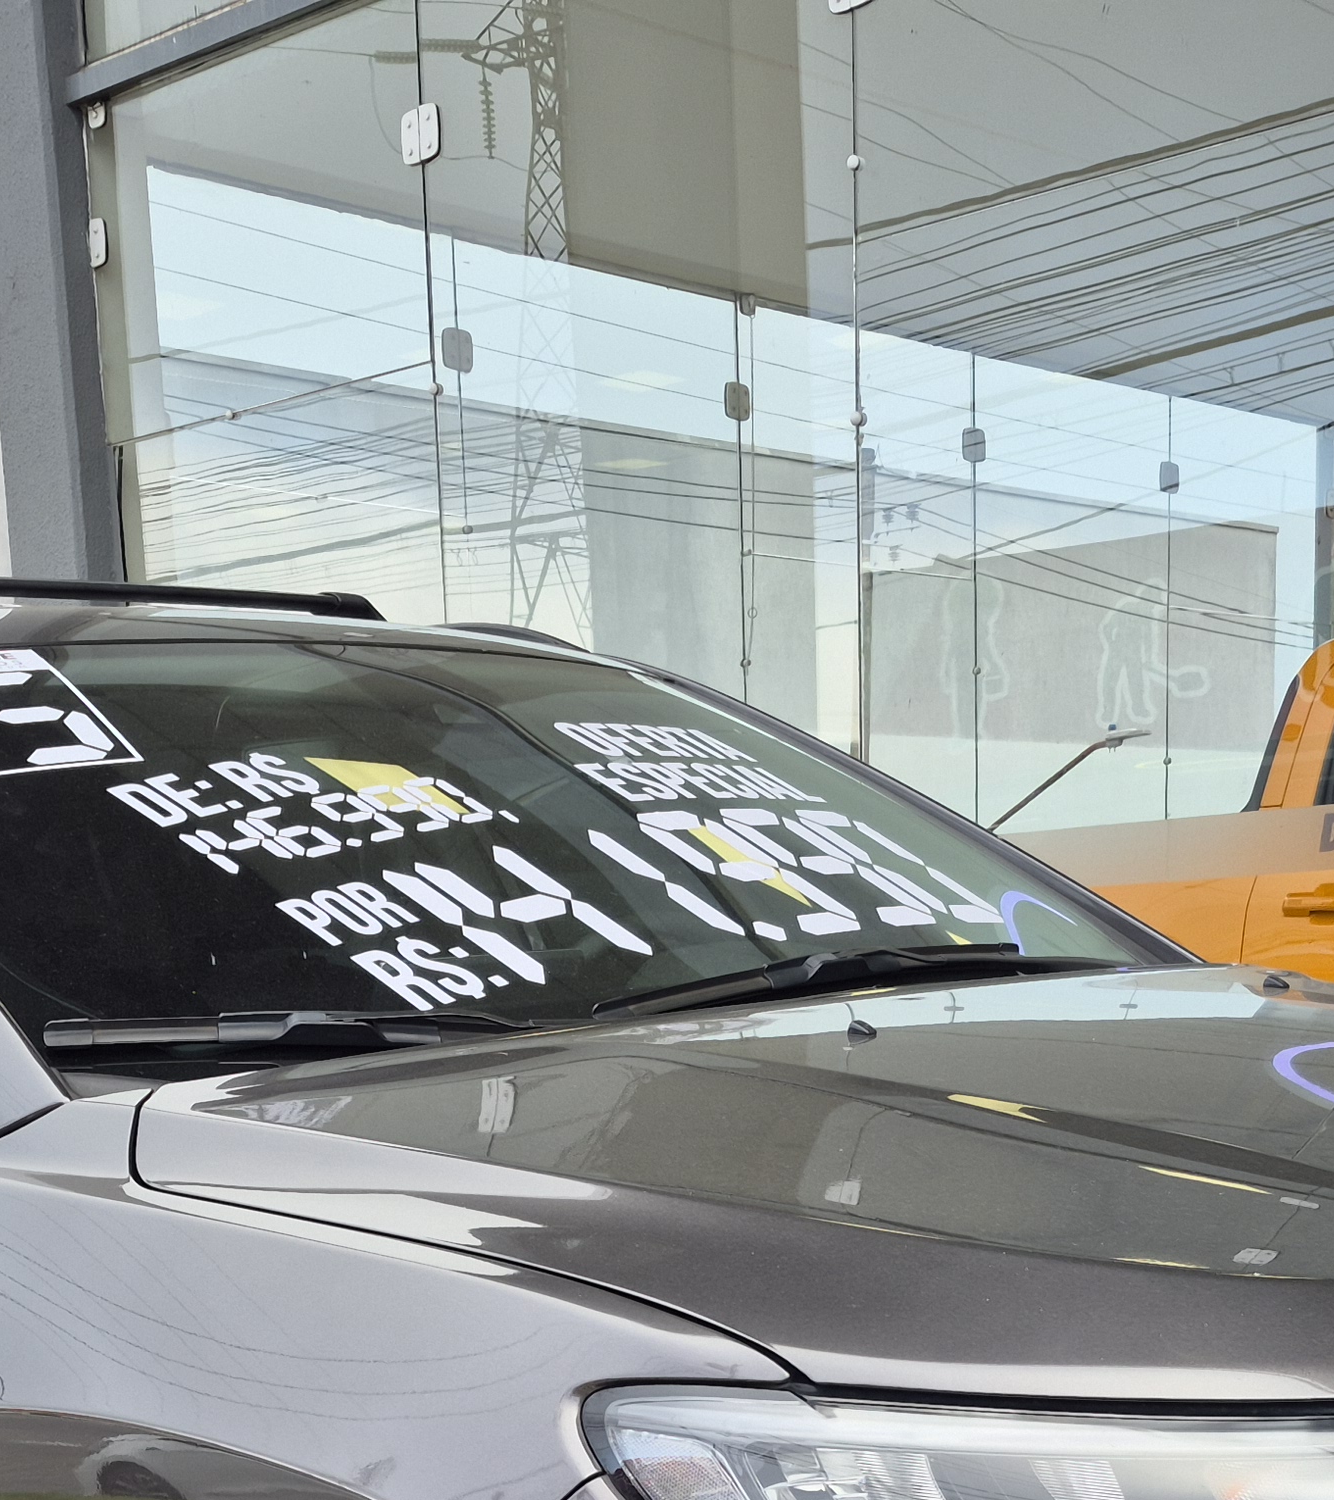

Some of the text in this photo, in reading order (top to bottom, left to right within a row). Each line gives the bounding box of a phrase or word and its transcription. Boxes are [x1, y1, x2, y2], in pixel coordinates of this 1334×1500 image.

[553, 722, 758, 763] OFERTA
[208, 752, 321, 802] R$
[573, 762, 827, 803] ESPECIAL
[275, 881, 420, 947] POR
